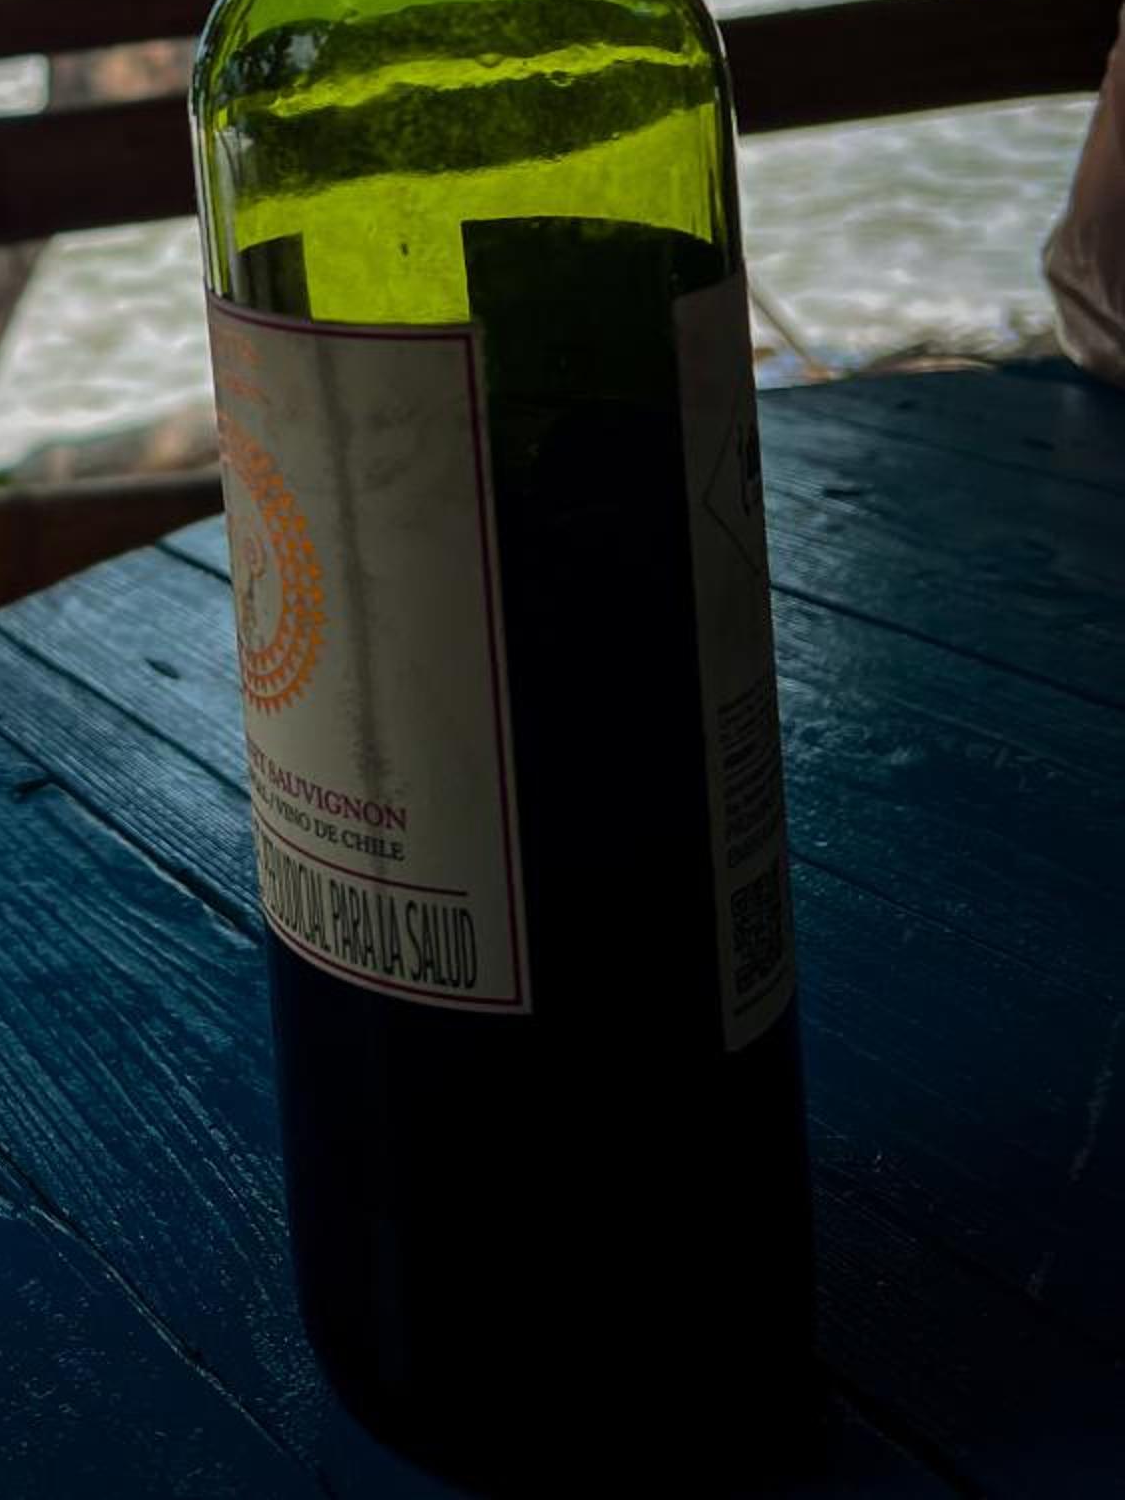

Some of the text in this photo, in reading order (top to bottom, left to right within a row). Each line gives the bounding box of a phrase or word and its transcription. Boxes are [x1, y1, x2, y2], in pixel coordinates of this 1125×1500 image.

[269, 761, 407, 832] SAUVIGNON
[314, 819, 340, 843] DE
[341, 831, 406, 862] CHILE
[330, 880, 375, 967] PARA
[377, 894, 405, 978] LA
[406, 900, 479, 990] SALUD
